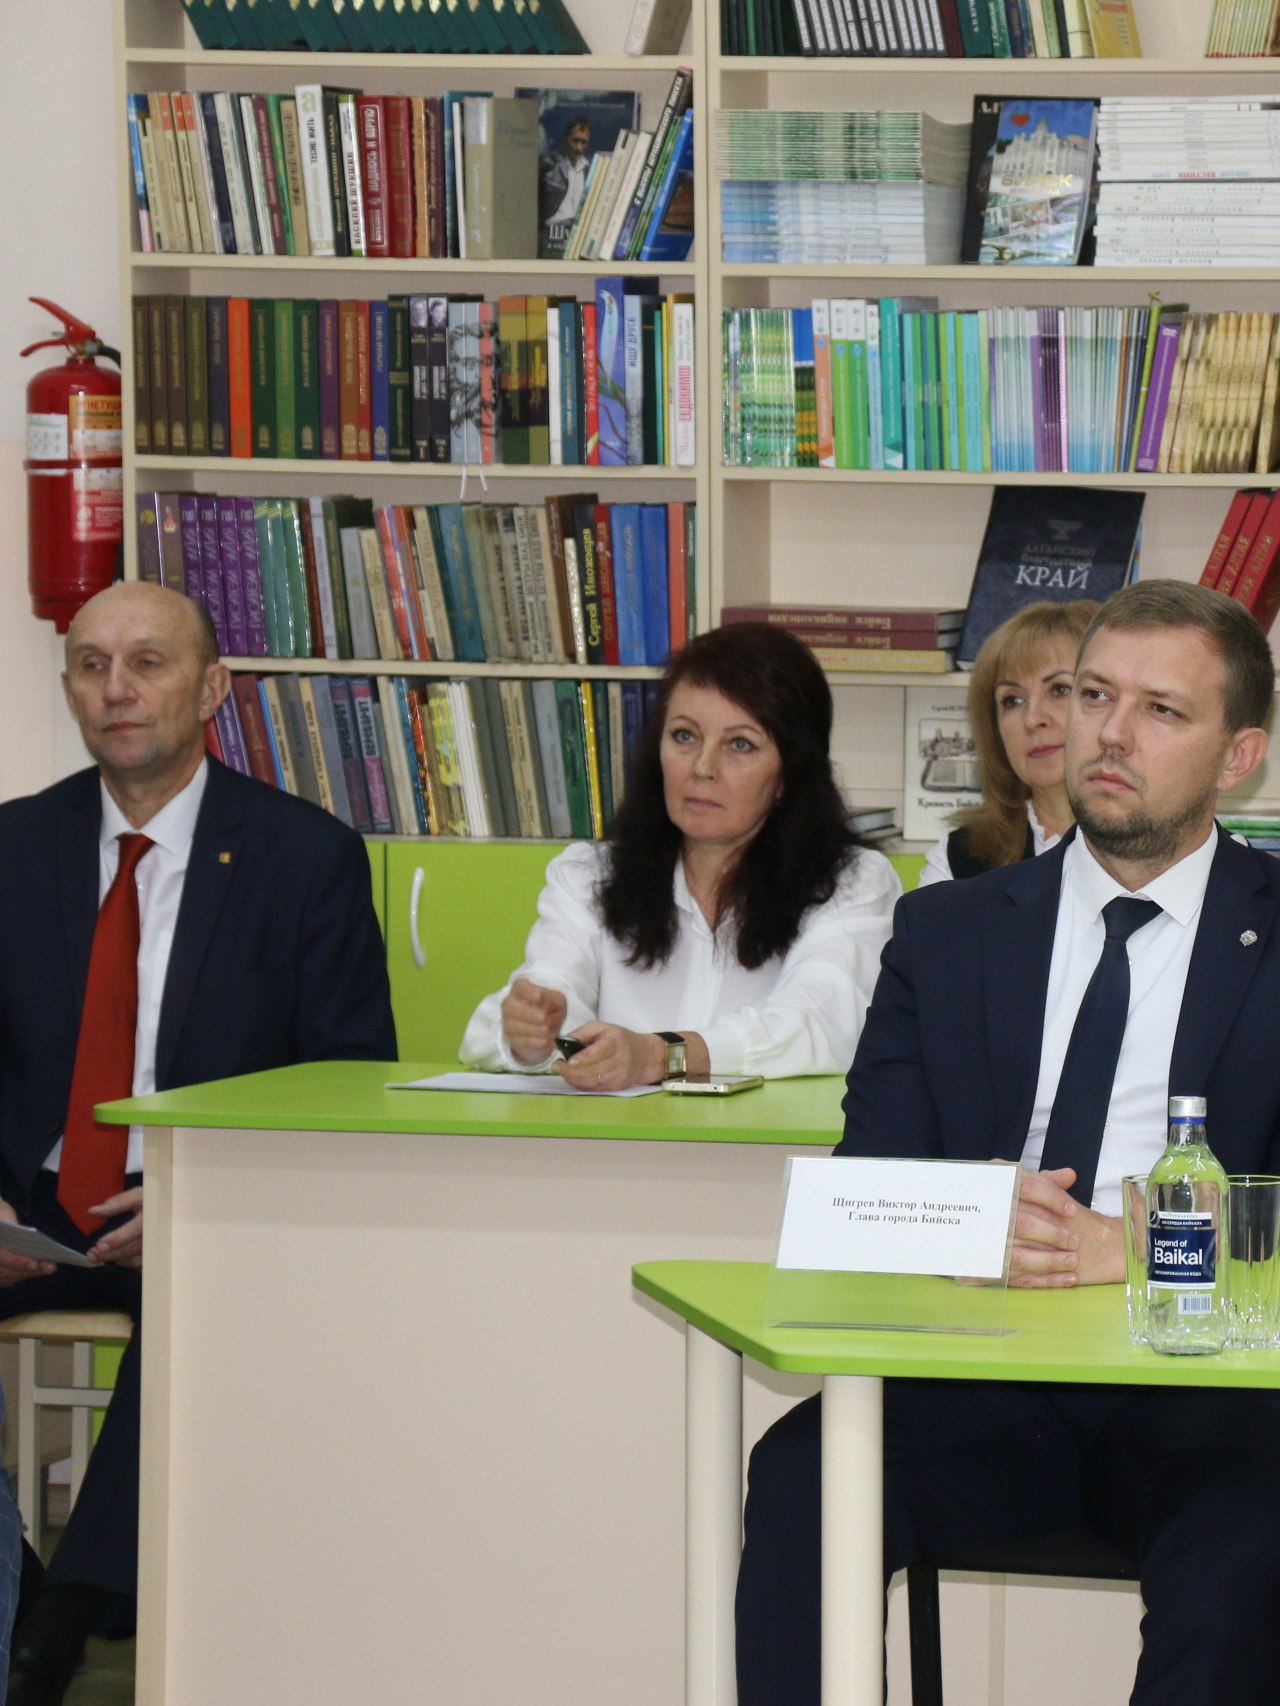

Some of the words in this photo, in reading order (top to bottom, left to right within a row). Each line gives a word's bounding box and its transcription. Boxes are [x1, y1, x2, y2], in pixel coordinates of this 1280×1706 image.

[665, 76, 684, 107] ПИКЕТА
[365, 109, 376, 138] ВЕРУЮ
[367, 141, 376, 149] И
[353, 200, 361, 244] ВАСИЛИЙ
[626, 317, 639, 345] ДРУГА
[627, 347, 639, 367] ИЩУ
[678, 365, 693, 421] ЕВДОКИМОВ
[581, 528, 597, 596] Иноземцев
[1024, 542, 1097, 557] АЛТАЙСКИЙ
[520, 563, 534, 595] ВЕТРЫ
[533, 562, 547, 595] ВЕТРЫ
[1014, 563, 1091, 590] КРАЙ
[585, 603, 602, 647] Сергей
[918, 798, 954, 809] Крепость
[832, 1197, 875, 1210] Щигрев
[878, 1199, 917, 1211] Виктор
[919, 1201, 981, 1213] Андреевич,
[848, 1211, 880, 1222] Глава
[882, 1214, 918, 1225] города
[921, 1214, 961, 1225] Бийска
[1154, 1238, 1179, 1248] Legend
[1179, 1239, 1188, 1248] of
[1154, 1247, 1203, 1265] Baikal
